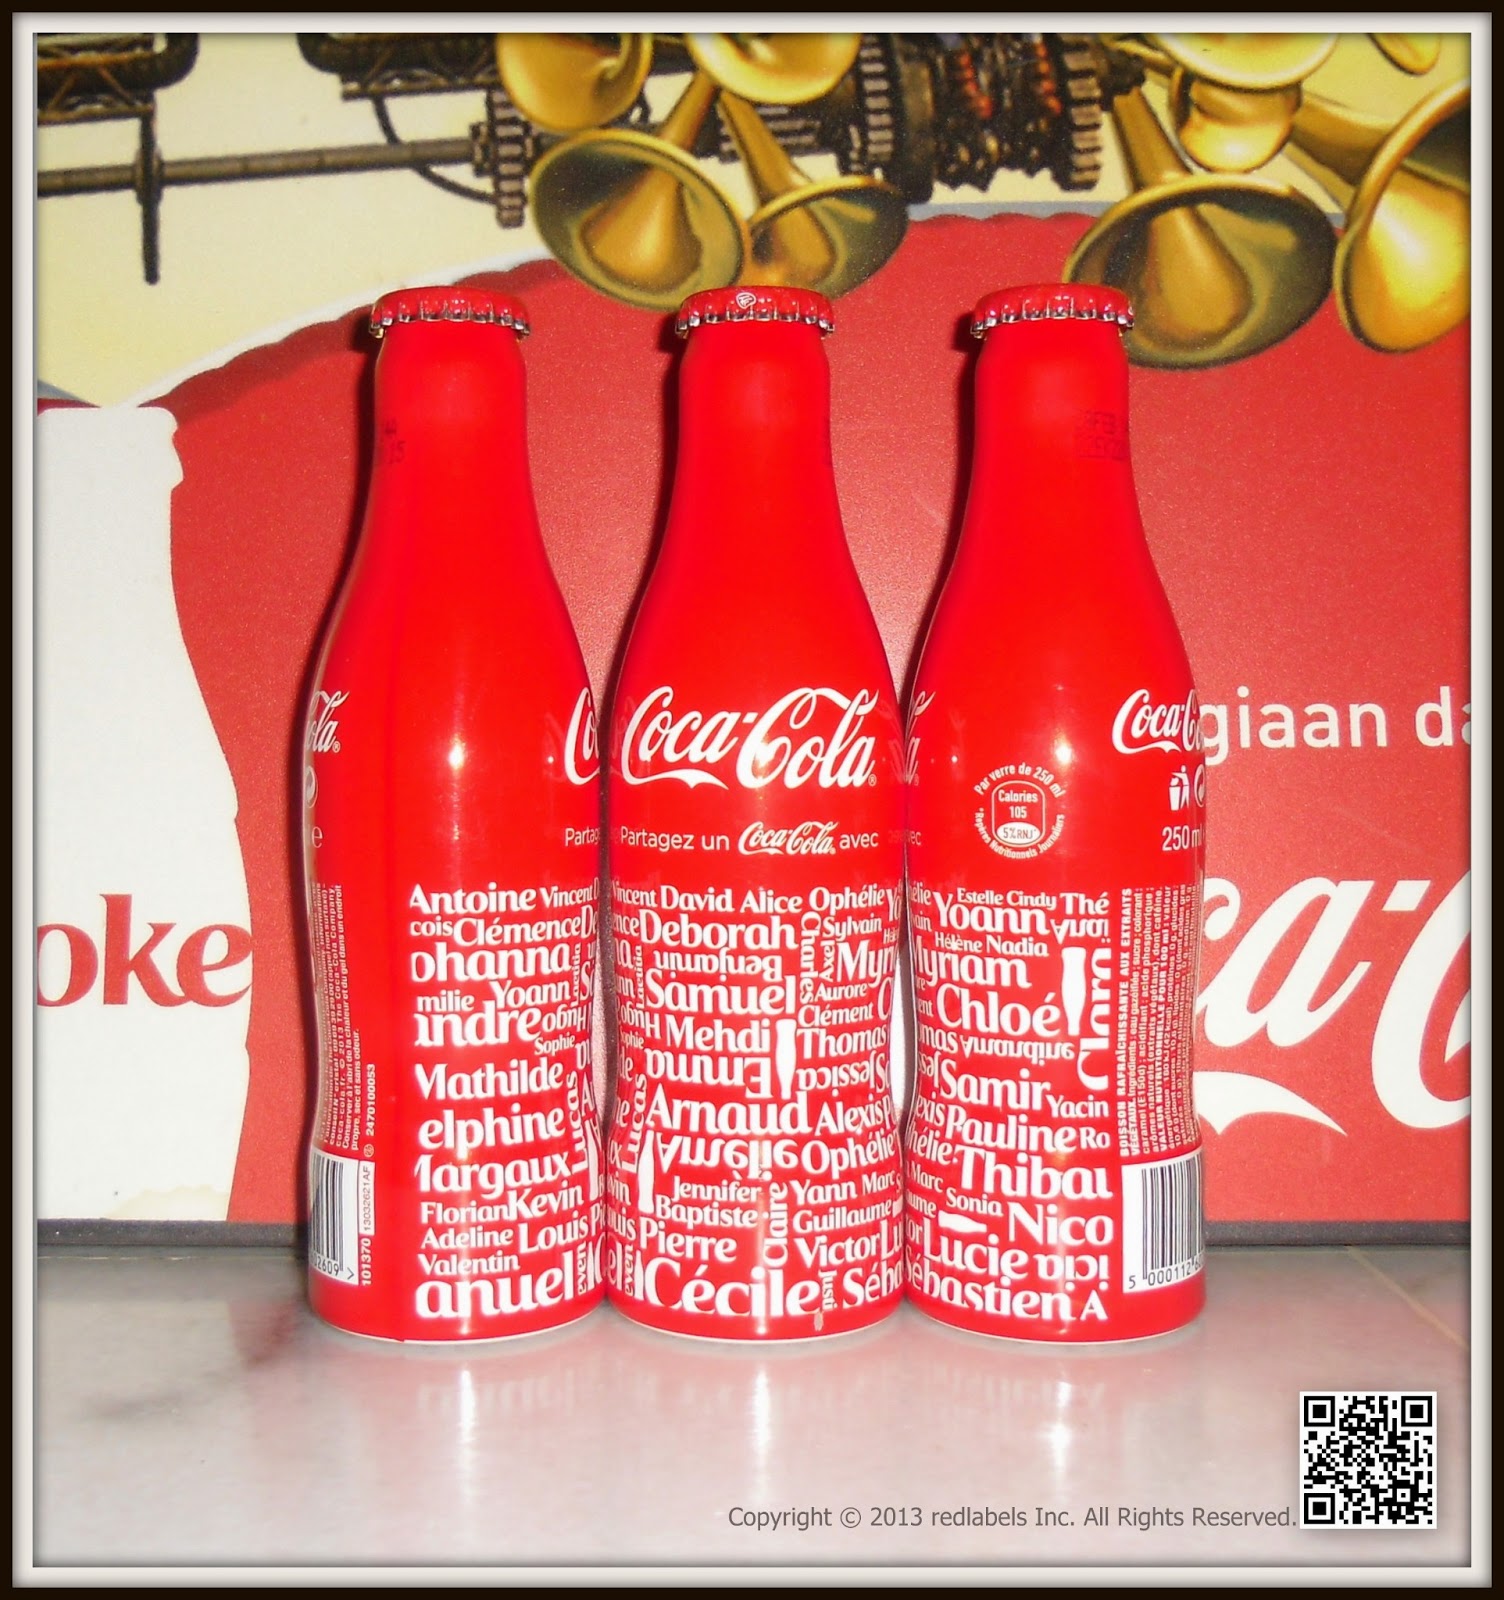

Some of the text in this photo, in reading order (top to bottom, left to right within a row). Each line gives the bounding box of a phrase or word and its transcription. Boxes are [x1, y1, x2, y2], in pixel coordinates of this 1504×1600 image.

[621, 686, 879, 790] Coca-Cola
[974, 762, 1066, 798] Par verre de 250 ml
[998, 790, 1038, 802] Calories
[1010, 806, 1027, 818] 105
[620, 821, 878, 855] Partagez un Coca-Cola avec
[1162, 825, 1190, 851] 250
[335, 885, 343, 919] endroit
[409, 882, 537, 914] Antoine
[540, 885, 594, 909] Vincent
[660, 885, 734, 912] David
[739, 886, 803, 914] Alice
[809, 883, 885, 916] Ophélie
[933, 892, 1050, 935] Yoann
[957, 888, 1109, 915] Estelle Cindy Thé
[1121, 888, 1131, 946] EXTRAITS
[338, 920, 344, 932] un
[410, 915, 453, 936] cois
[453, 916, 581, 946] Clémence
[639, 909, 799, 951] Deborah
[822, 913, 882, 942] Sylvain
[935, 931, 1049, 957] Hélène Nadia
[1143, 893, 1153, 966] phosphorique
[1152, 932, 1160, 955] dont
[1162, 929, 1169, 943] ml
[340, 959, 348, 974] gel
[654, 947, 782, 982] Benjamin
[800, 911, 821, 1004] Charles
[819, 940, 835, 982] Axel
[913, 936, 1032, 989] Myriam
[1120, 952, 1130, 976] AUX
[1160, 946, 1168, 967] 100
[341, 976, 348, 988] du
[342, 989, 349, 999] et
[417, 989, 475, 1012] milie
[489, 980, 570, 1010] Yoann
[646, 968, 796, 1015] Samuel
[814, 983, 868, 1002] Aurore
[1127, 1041, 1137, 1097] Ingrédients
[1133, 893, 1143, 932] colorant
[1159, 971, 1167, 1001] POUR
[343, 1001, 352, 1038] chaleur
[542, 1004, 586, 1033] Hugo
[621, 1002, 770, 1052] Hugo Mehdi
[798, 1003, 873, 1027] Clément
[937, 983, 1061, 1036] Chloé
[346, 1050, 352, 1061] de
[534, 1032, 575, 1055] Sophie
[797, 1024, 887, 1060] Thomas
[1155, 1004, 1165, 1103] NUTRITIONNELLE
[354, 1084, 361, 1094] et
[414, 1056, 564, 1100] Mathilde
[644, 1049, 773, 1099] Emma
[796, 1051, 875, 1097] Jessica
[940, 1058, 1052, 1111] Samir
[1147, 1064, 1155, 1109] naturels
[366, 1064, 375, 1136] 2470100053
[645, 1083, 813, 1136] Arnaud
[815, 1094, 884, 1137] Alexis
[1046, 1095, 1109, 1119] Yacin
[342, 1098, 353, 1148] Conserver
[418, 1102, 566, 1160] elphine
[567, 1070, 588, 1175] Lucas
[621, 1073, 648, 1174] Lucas
[946, 1104, 1110, 1154] Pauline Ro
[1117, 1101, 1130, 1157] BOISSON
[1138, 1109, 1150, 1153] caramel
[1148, 1112, 1159, 1152] arômes
[1156, 1106, 1167, 1151] VALEUR
[801, 1129, 895, 1180] Ophélie
[420, 1200, 509, 1225] Florian
[507, 1180, 584, 1221] Kevin
[789, 1170, 895, 1205] Yann Marc
[911, 1162, 943, 1194] Marc
[946, 1187, 1003, 1217] Sonia
[420, 1225, 513, 1249] Adeline
[518, 1210, 588, 1254] Louis
[655, 1194, 759, 1230] Baptiste
[763, 1182, 788, 1268] Claire
[793, 1198, 891, 1233] Guillaume
[1008, 1202, 1114, 1246] Nico
[639, 1217, 737, 1263] Pierre
[794, 1230, 881, 1268] Victor
[923, 1217, 1029, 1280] Lucie
[361, 1238, 372, 1286] 101370
[417, 1250, 520, 1276] Valentin
[1129, 1275, 1135, 1288] 5
[415, 1249, 573, 1319] anuel
[645, 1256, 821, 1317] Cécile
[907, 1246, 1076, 1321] Sébastien
[1080, 1290, 1108, 1321] A
